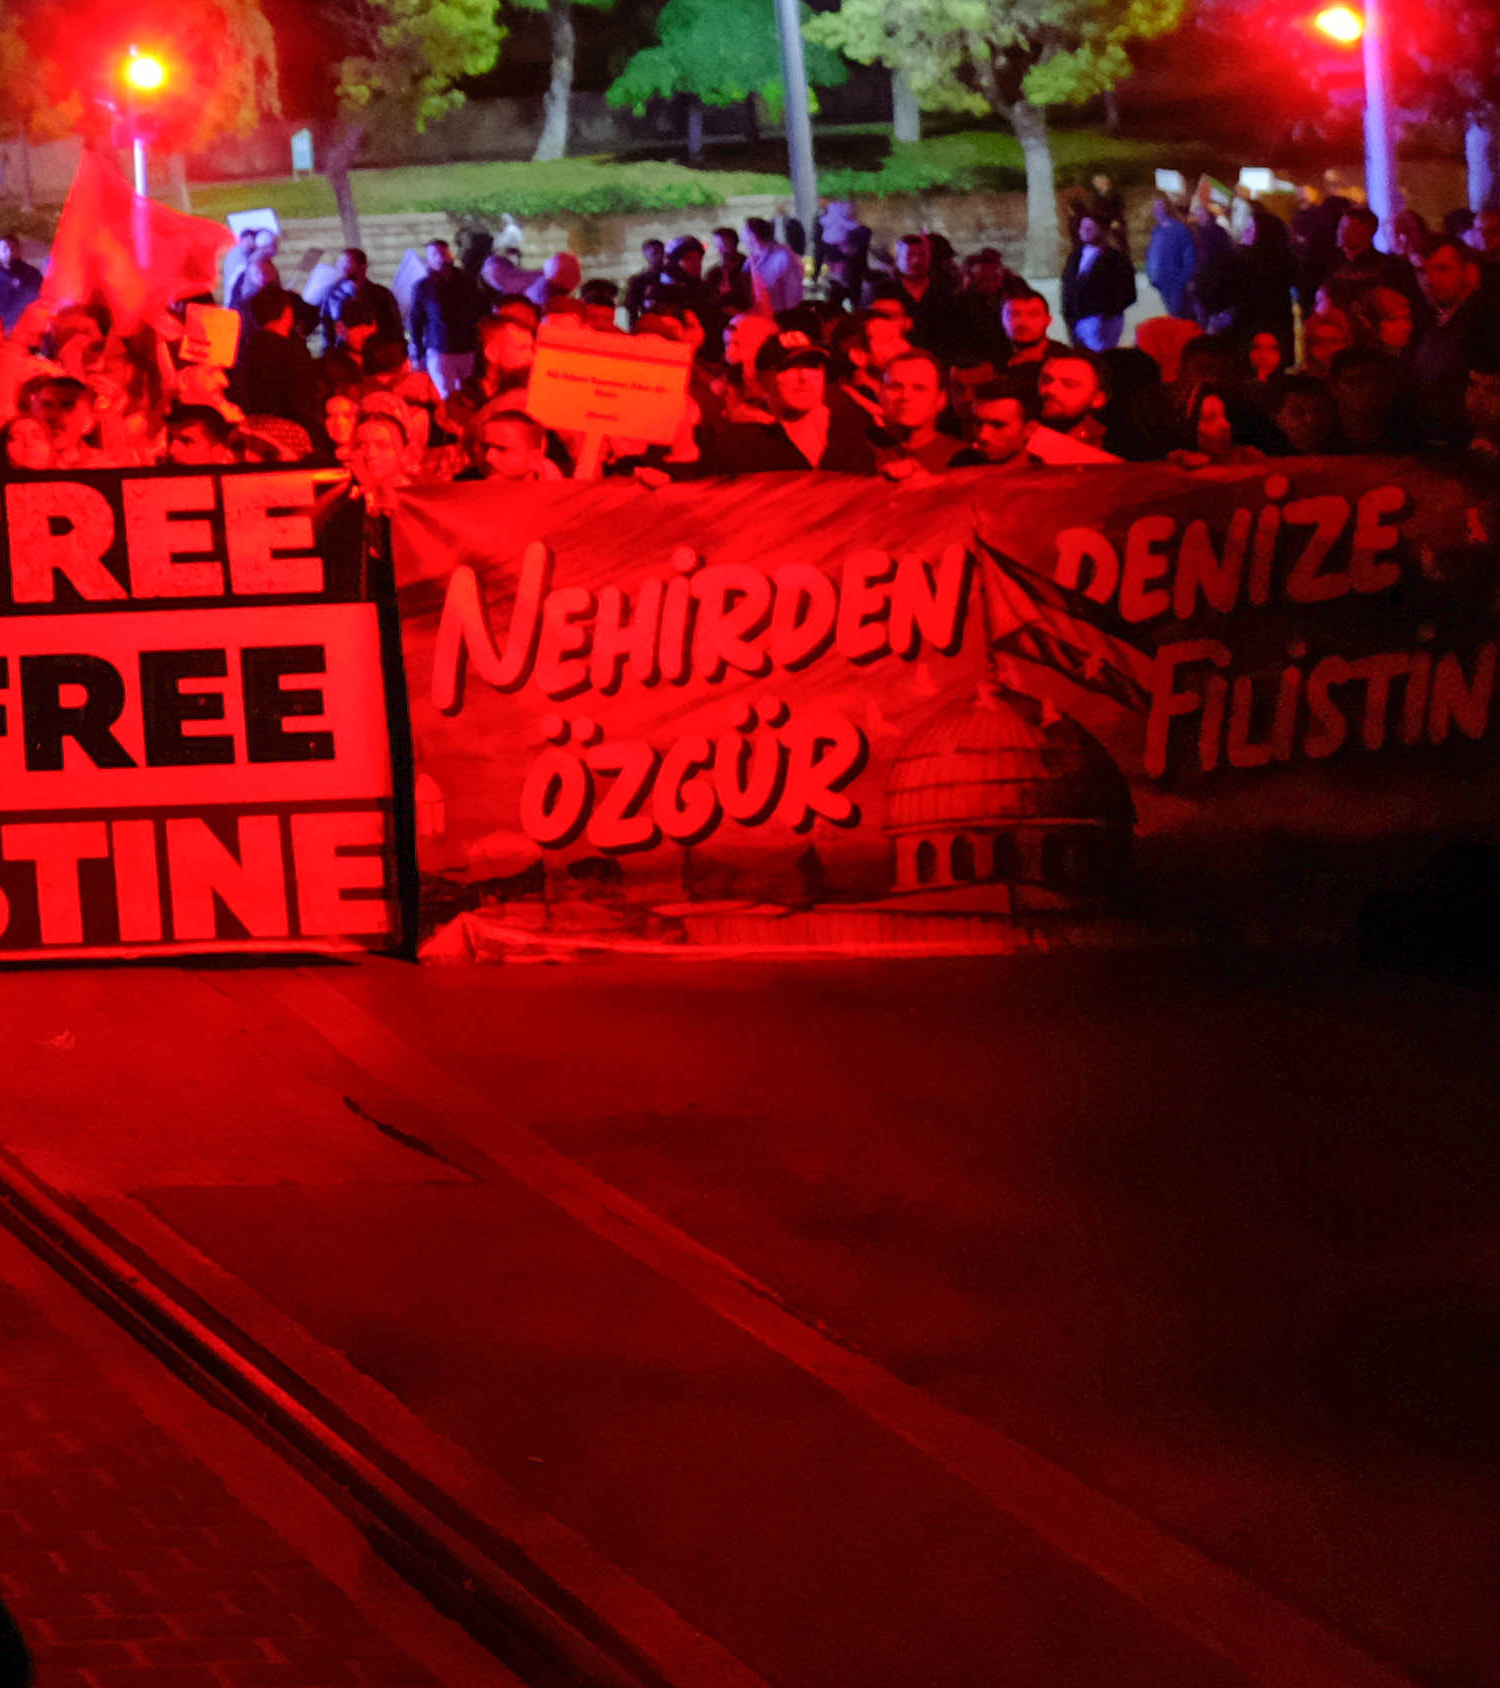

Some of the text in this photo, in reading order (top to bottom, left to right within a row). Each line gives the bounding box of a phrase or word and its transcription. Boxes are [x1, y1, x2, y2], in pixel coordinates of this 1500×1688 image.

[431, 478, 1405, 713] NEHİRDEN DENİZE
[520, 698, 862, 848] ÖZGÜR
